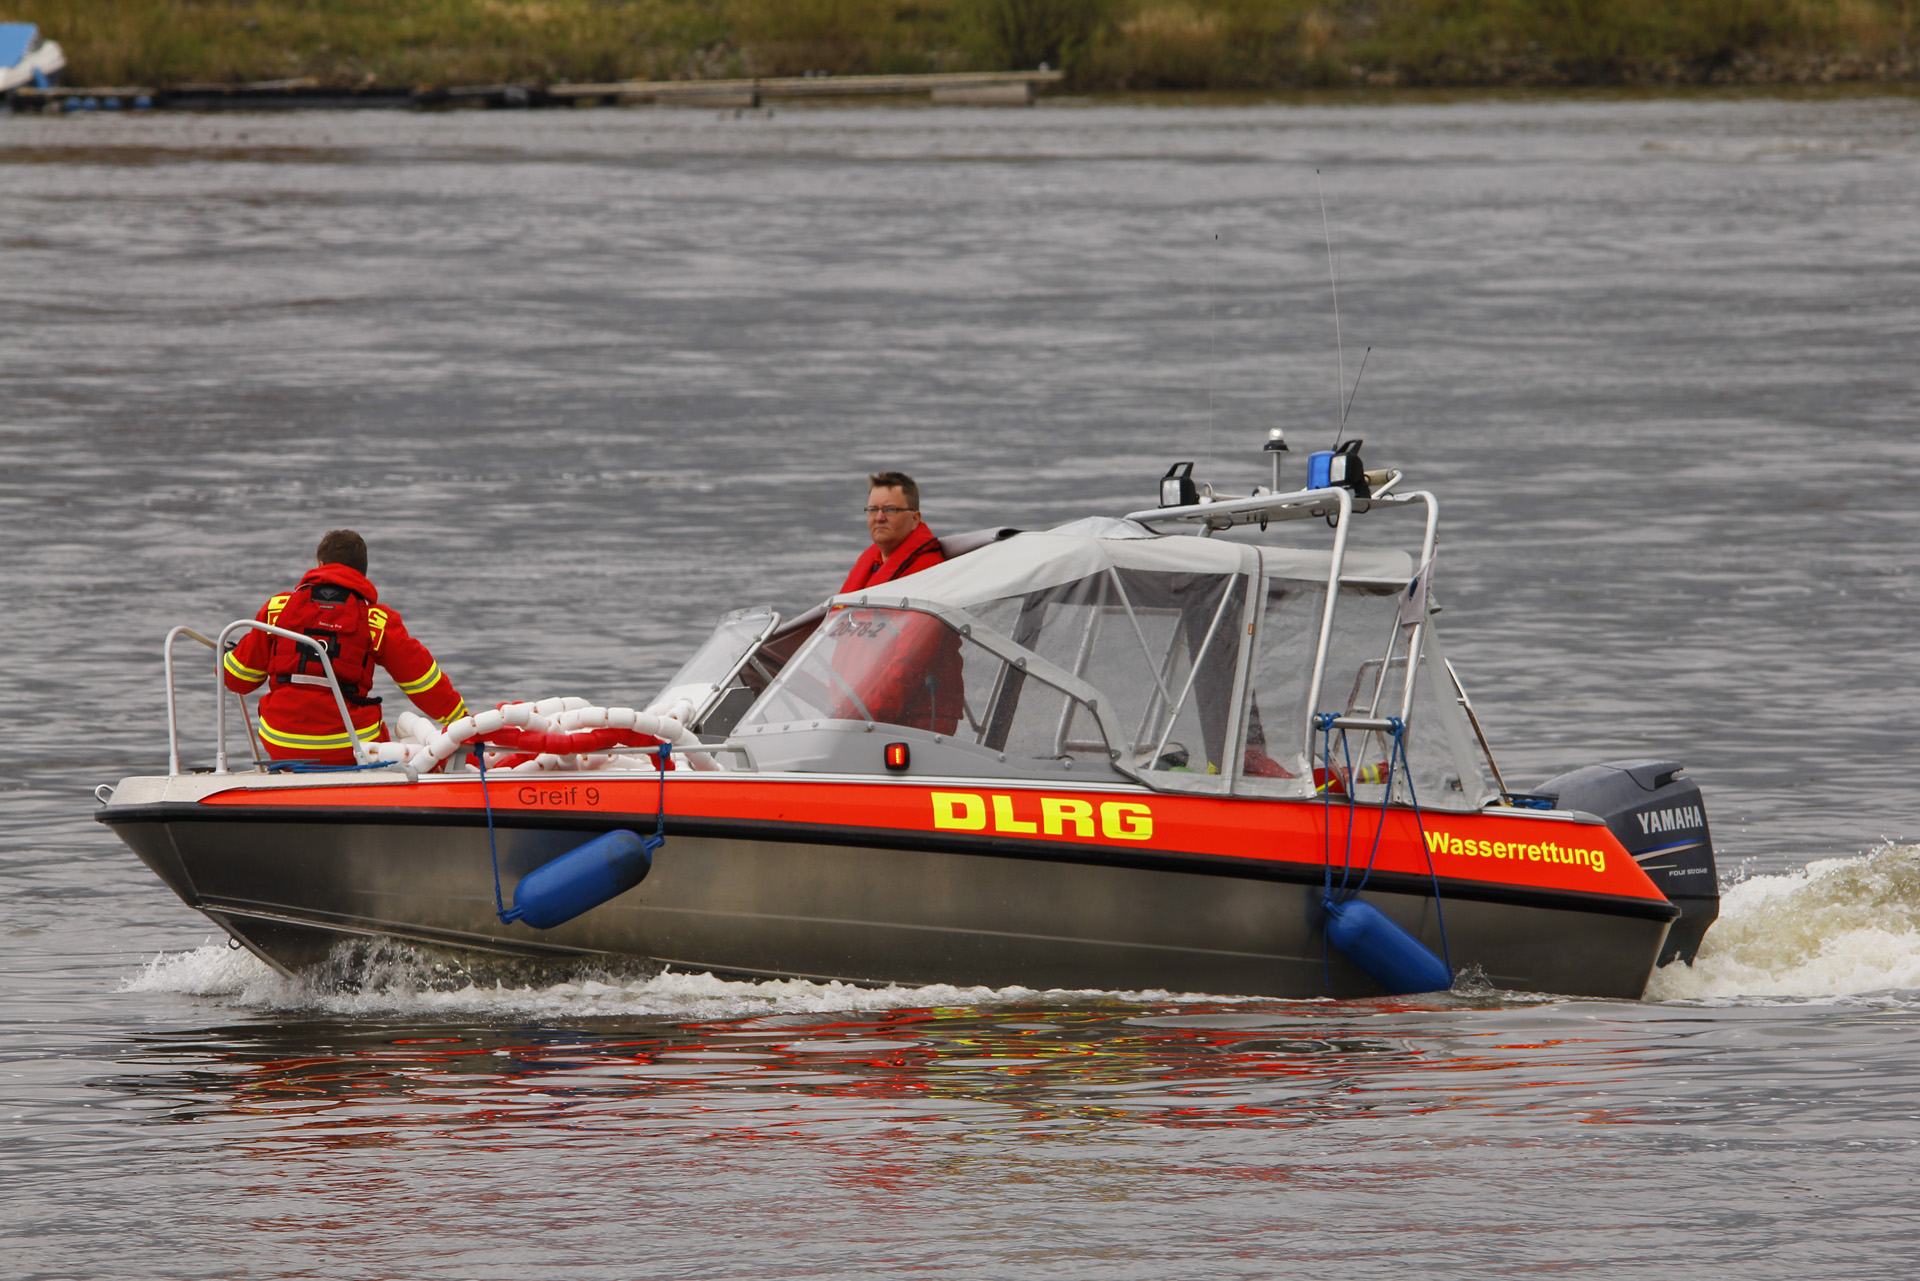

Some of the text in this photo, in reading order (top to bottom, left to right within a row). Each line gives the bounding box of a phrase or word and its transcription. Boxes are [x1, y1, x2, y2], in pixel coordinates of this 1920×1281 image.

[518, 786, 600, 806] Greif 9
[931, 792, 1153, 840] DLRG
[1636, 805, 1703, 835] YAMAHA
[1424, 831, 1606, 872] Wasserrettung
